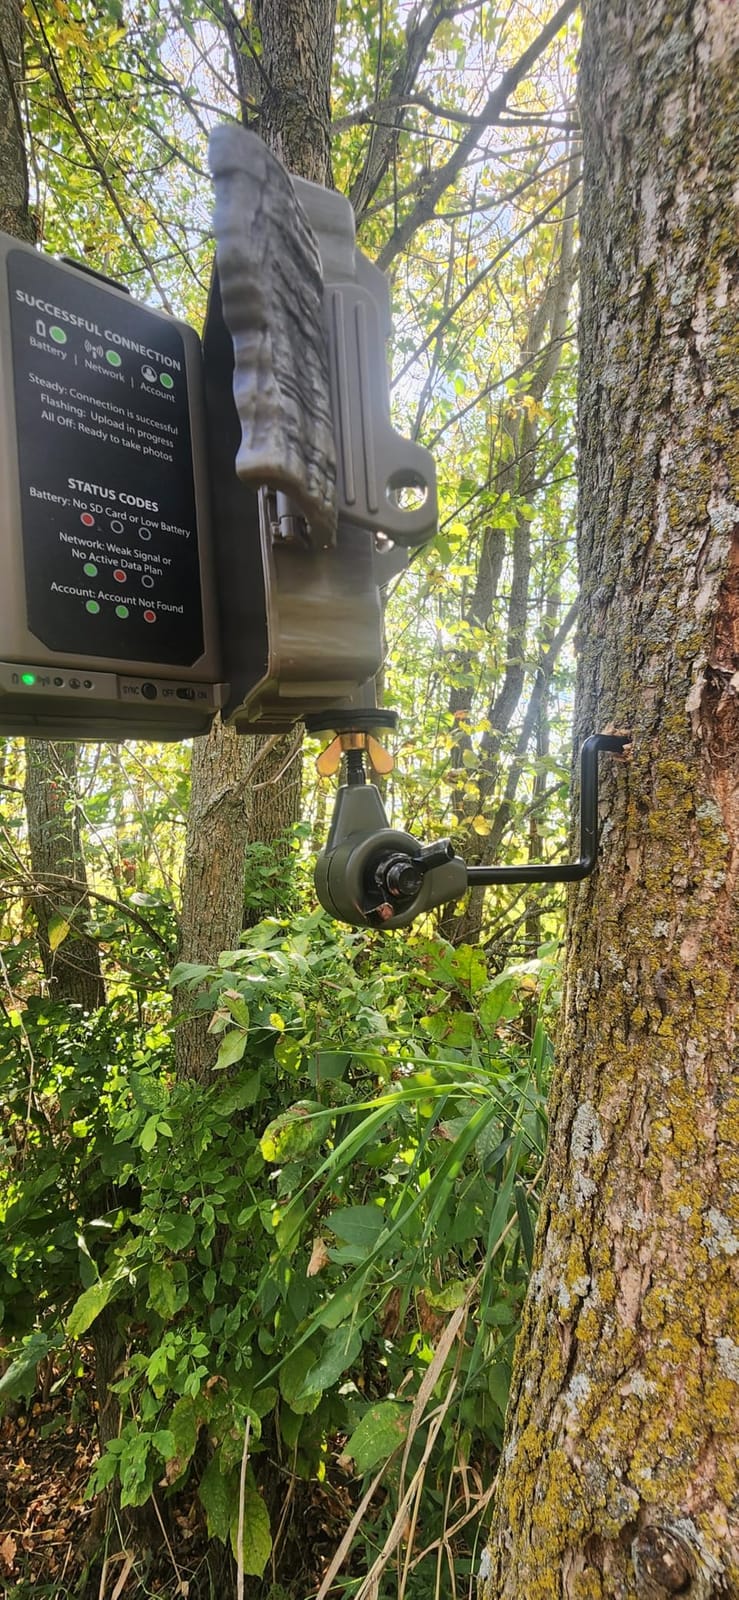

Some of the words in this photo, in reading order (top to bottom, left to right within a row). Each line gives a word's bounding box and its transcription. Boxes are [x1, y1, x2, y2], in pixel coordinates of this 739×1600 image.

[15, 289, 102, 337] SUCCESSFUL
[104, 330, 181, 371] CONNECTION
[29, 335, 67, 360] Battery
[84, 359, 125, 382] Network
[28, 372, 68, 394] Steady:
[69, 388, 125, 415] Connection
[126, 409, 134, 419] is
[135, 414, 178, 435] successful
[140, 382, 176, 402] Account
[40, 393, 87, 418] Flashing:
[90, 410, 125, 430] Upload
[126, 423, 136, 434] in
[137, 430, 174, 448] progress
[41, 410, 55, 422] All
[56, 415, 76, 430] Off:
[78, 422, 108, 441] Ready
[109, 434, 120, 444] to
[121, 438, 141, 451] take
[142, 446, 173, 462] photos
[67, 478, 116, 500] STATUS
[118, 492, 159, 512] CODES
[29, 486, 71, 507] Battery:
[72, 498, 88, 510] No
[89, 502, 103, 514] SD
[105, 507, 127, 520] Card
[128, 515, 139, 523] or
[140, 516, 159, 529] Low
[160, 521, 191, 539] Battery
[59, 531, 105, 550] Network:
[105, 542, 132, 557] Weak
[133, 549, 161, 562] Signal
[162, 557, 172, 566] or
[71, 548, 87, 560] No
[88, 552, 119, 567] Active
[120, 559, 142, 571] Data
[143, 564, 163, 576] Plan
[50, 581, 96, 599] Account:
[97, 591, 137, 606] Account
[138, 597, 155, 609] Not
[156, 600, 184, 614] Found
